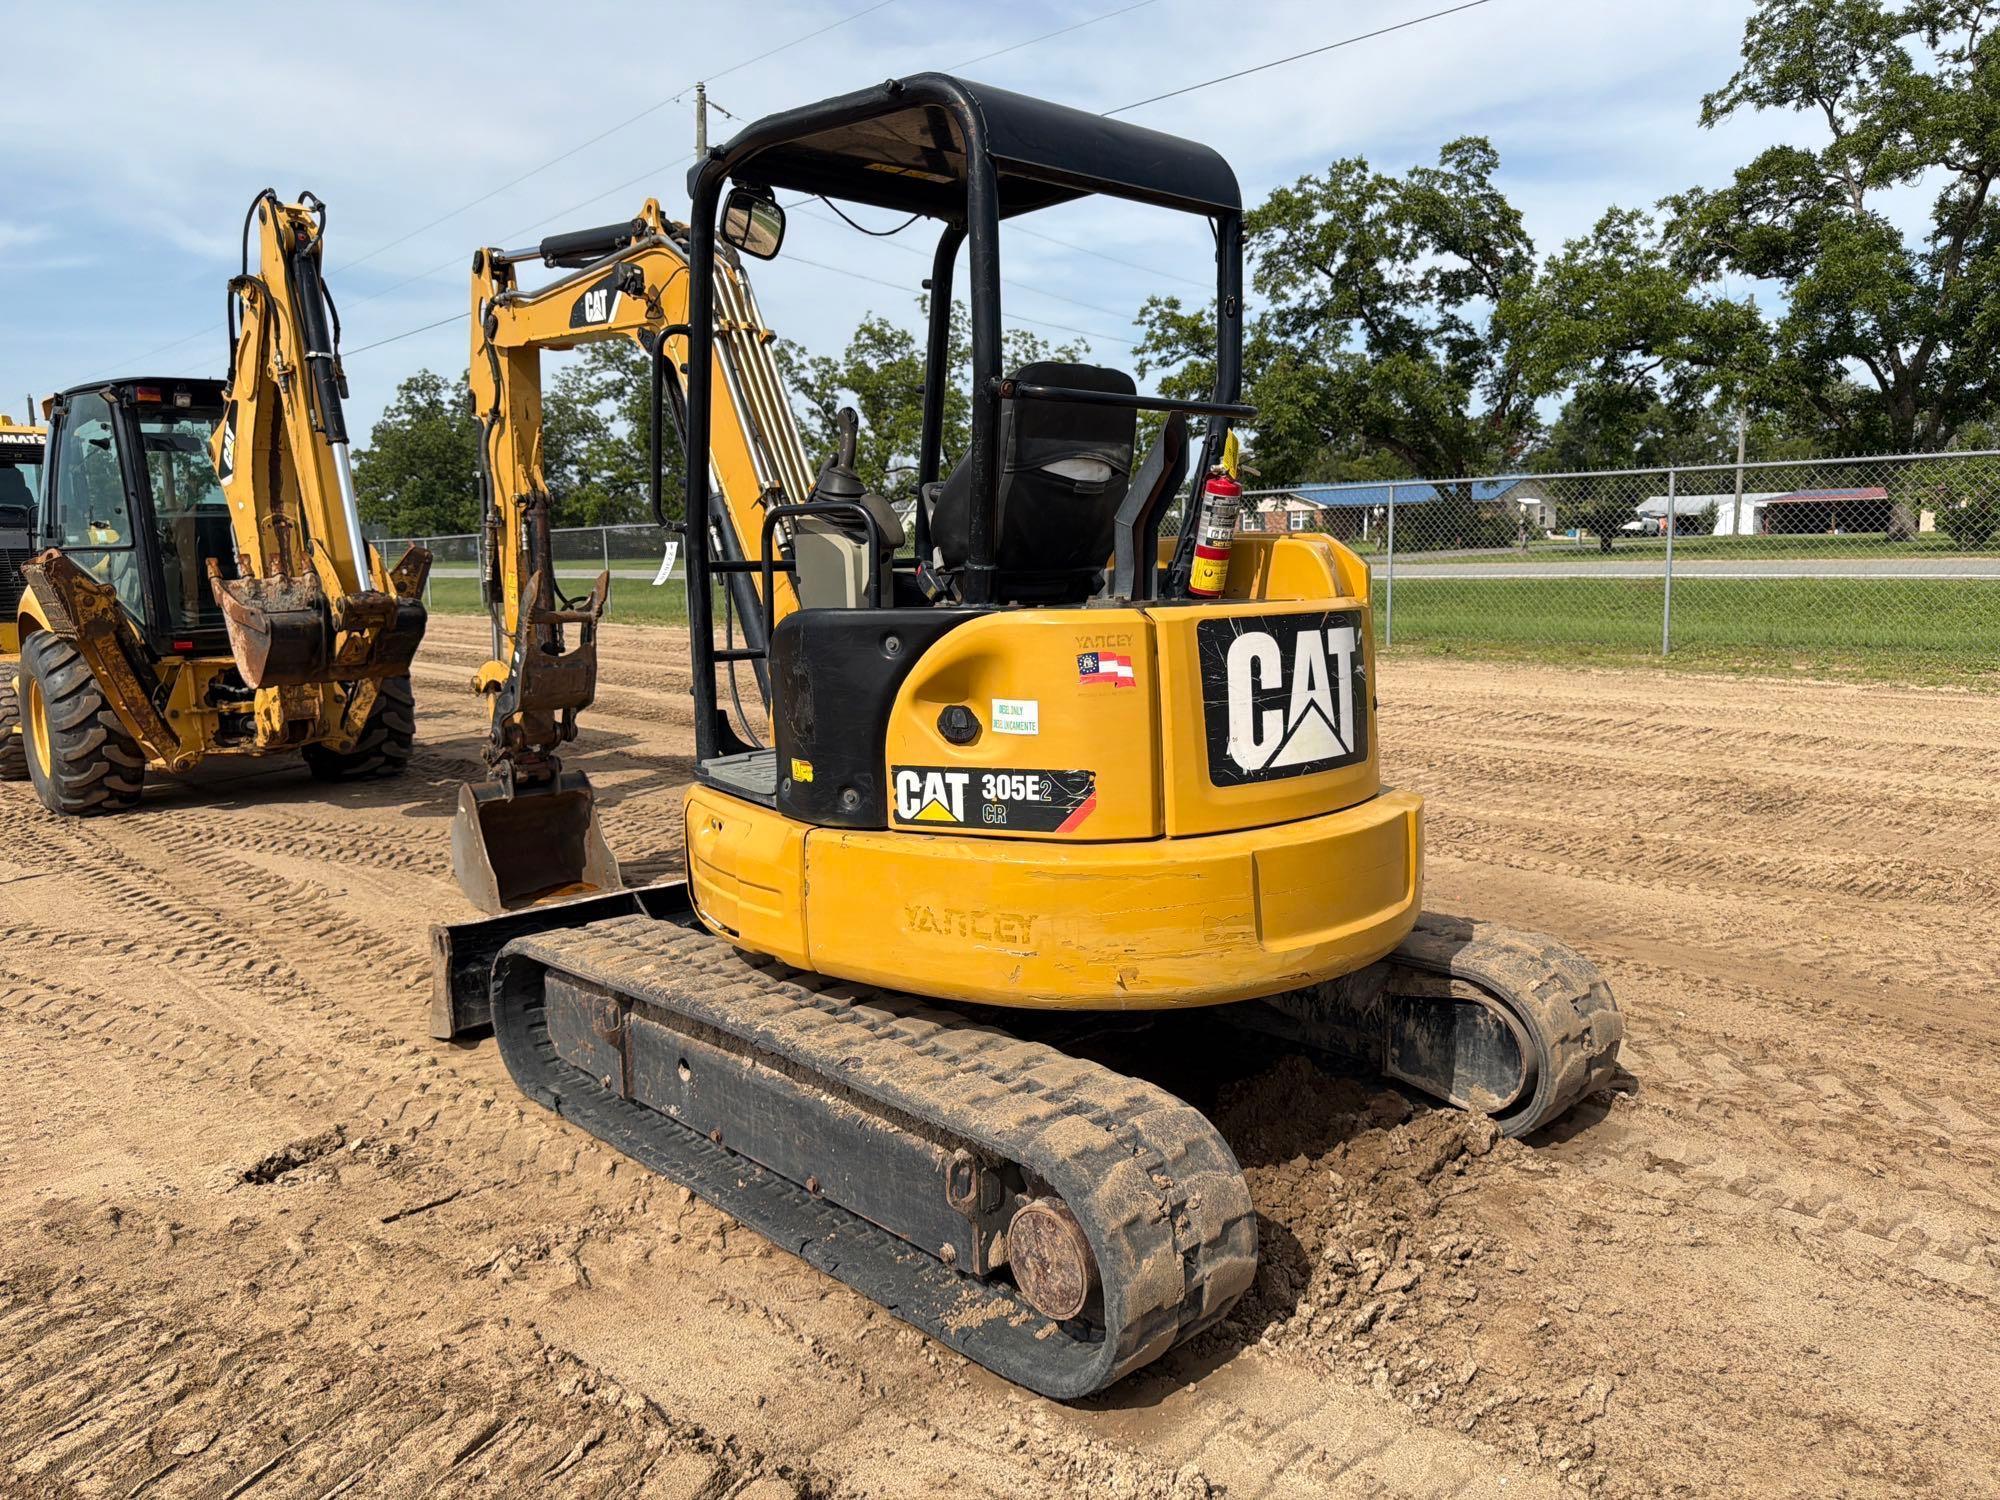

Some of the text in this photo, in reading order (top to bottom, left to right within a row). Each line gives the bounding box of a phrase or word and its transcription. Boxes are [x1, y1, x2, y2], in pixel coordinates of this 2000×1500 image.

[585, 289, 607, 322] CAT
[0, 434, 46, 444] MATS
[223, 420, 235, 470] CAT
[1075, 634, 1134, 648] YANCEY
[1227, 627, 1356, 770] CAT
[896, 770, 1051, 822] CAT 305E2
[982, 804, 1007, 824] CR
[905, 905, 1039, 944] YANCEY
